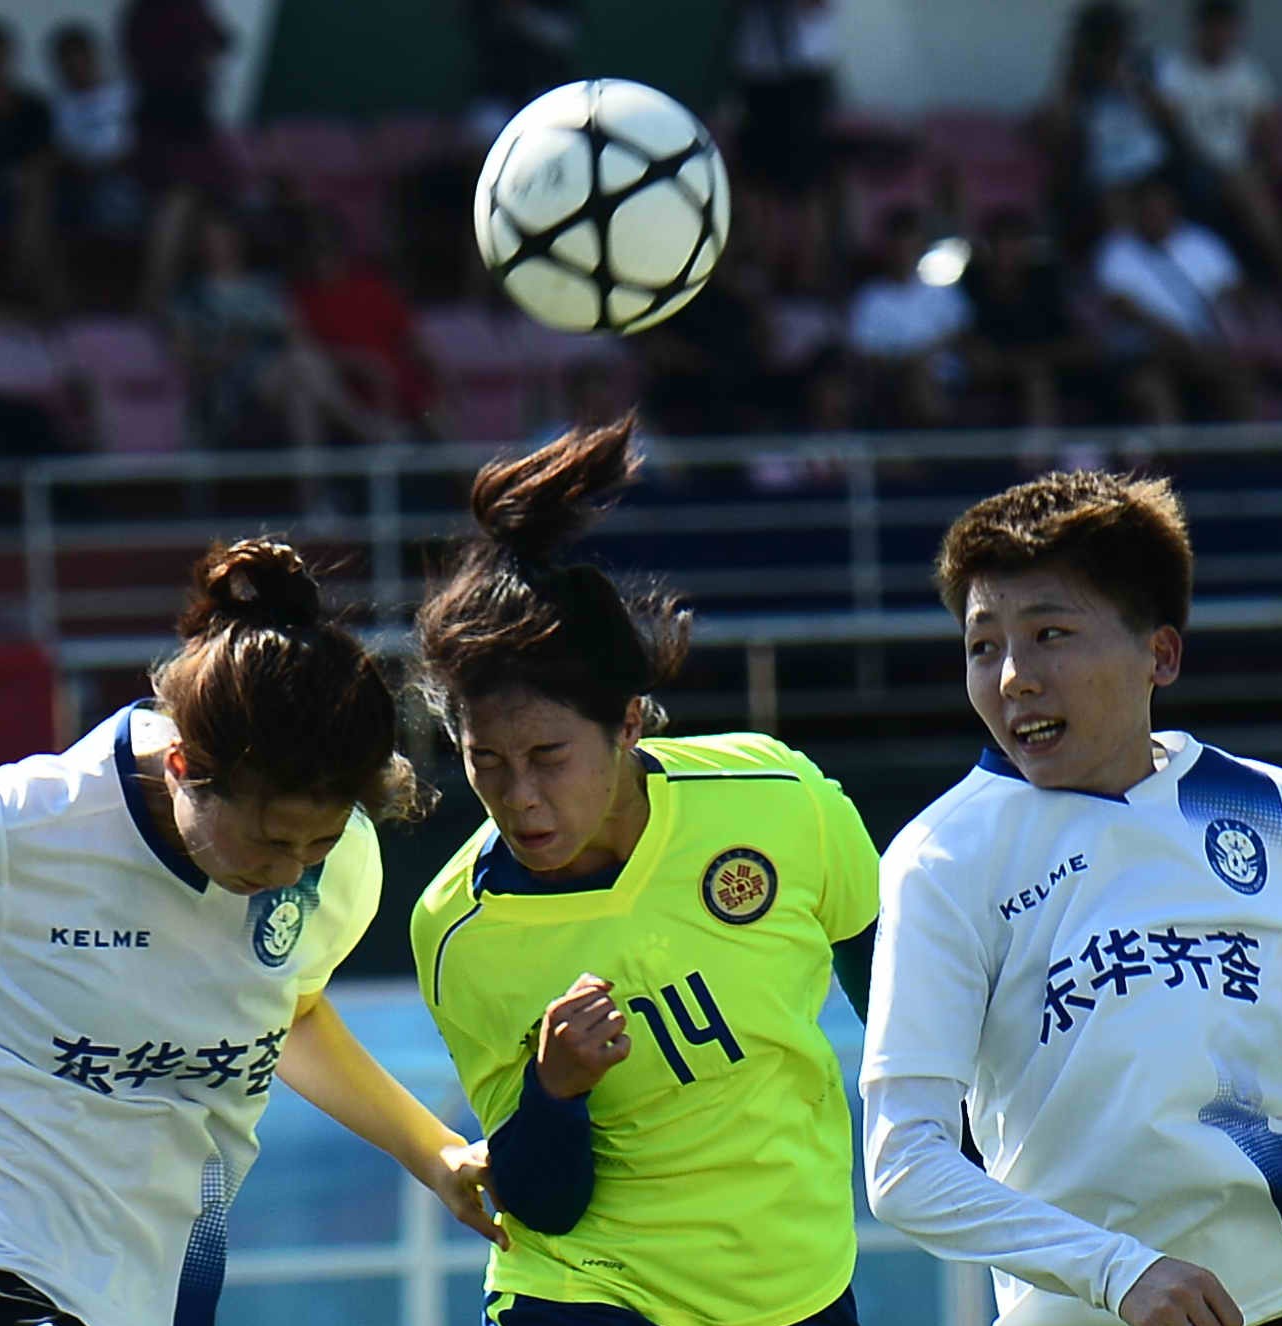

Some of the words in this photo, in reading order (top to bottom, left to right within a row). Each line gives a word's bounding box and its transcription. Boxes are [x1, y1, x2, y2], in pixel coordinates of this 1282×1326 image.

[999, 853, 1088, 921] KELME
[51, 927, 151, 949] KELME
[628, 971, 745, 1086] 14
